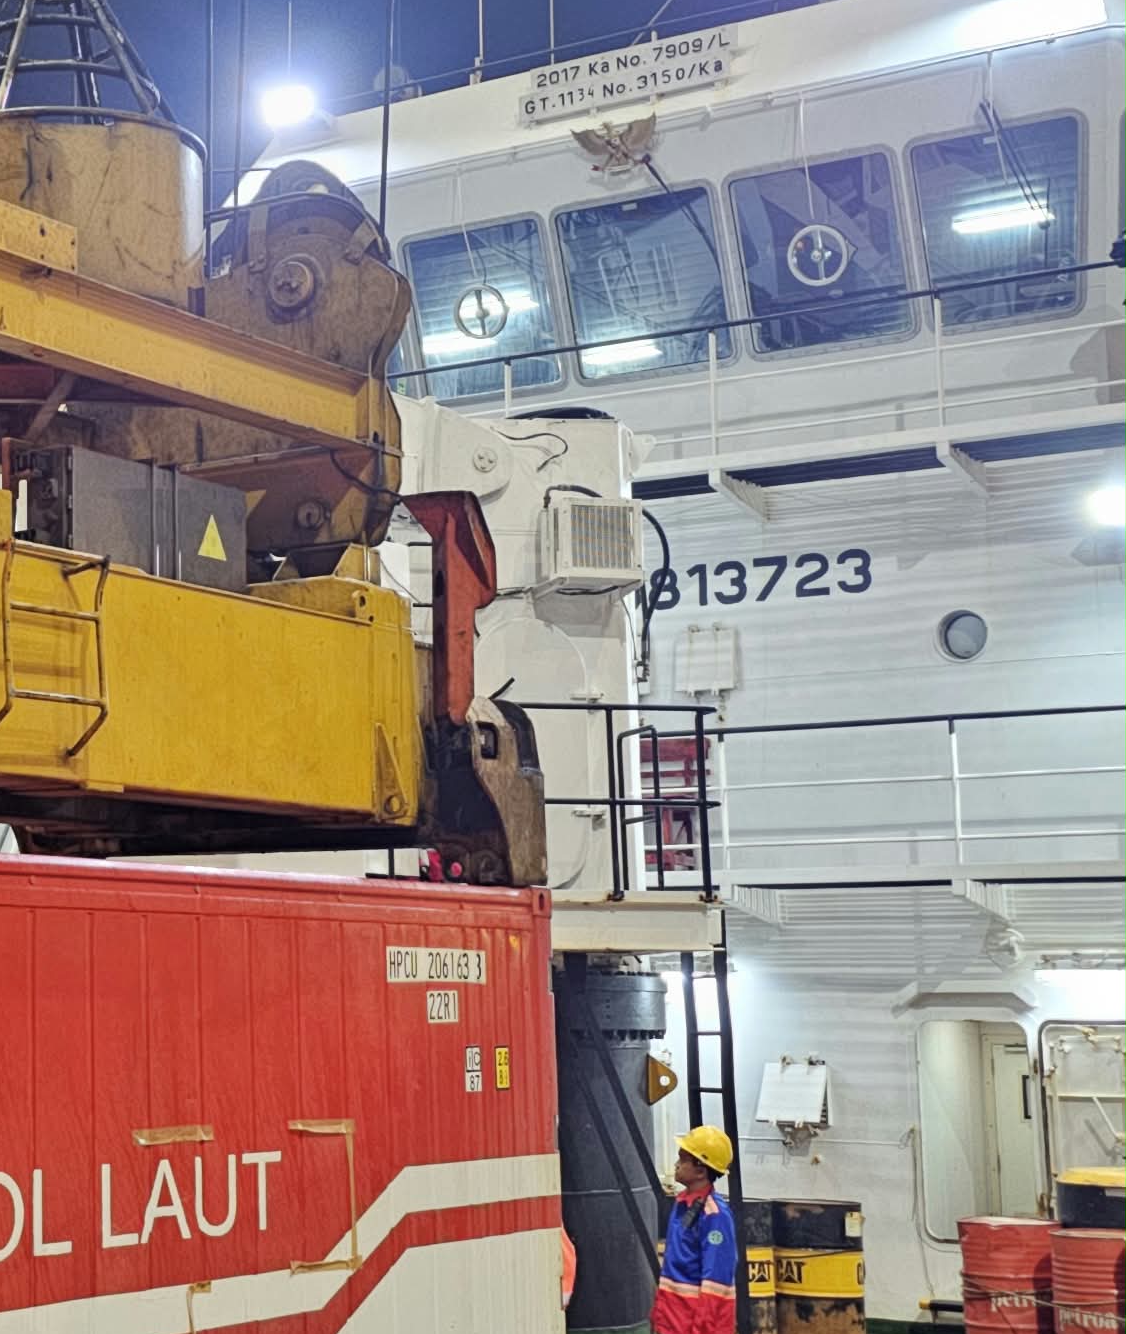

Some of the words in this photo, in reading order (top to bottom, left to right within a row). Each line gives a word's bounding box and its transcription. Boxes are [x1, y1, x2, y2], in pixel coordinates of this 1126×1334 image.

[536, 65, 581, 88] 2017
[588, 61, 610, 76] Ka
[617, 54, 647, 71] No.
[653, 32, 731, 62] 7909/L
[635, 548, 872, 611] 813723
[388, 950, 418, 979] HPCU
[428, 951, 470, 980] 206163
[475, 953, 482, 980] 3
[428, 992, 457, 1020] 22R1
[469, 1074, 480, 1091] 87
[100, 1150, 283, 1249] LAUT
[777, 1259, 806, 1284] CAT
